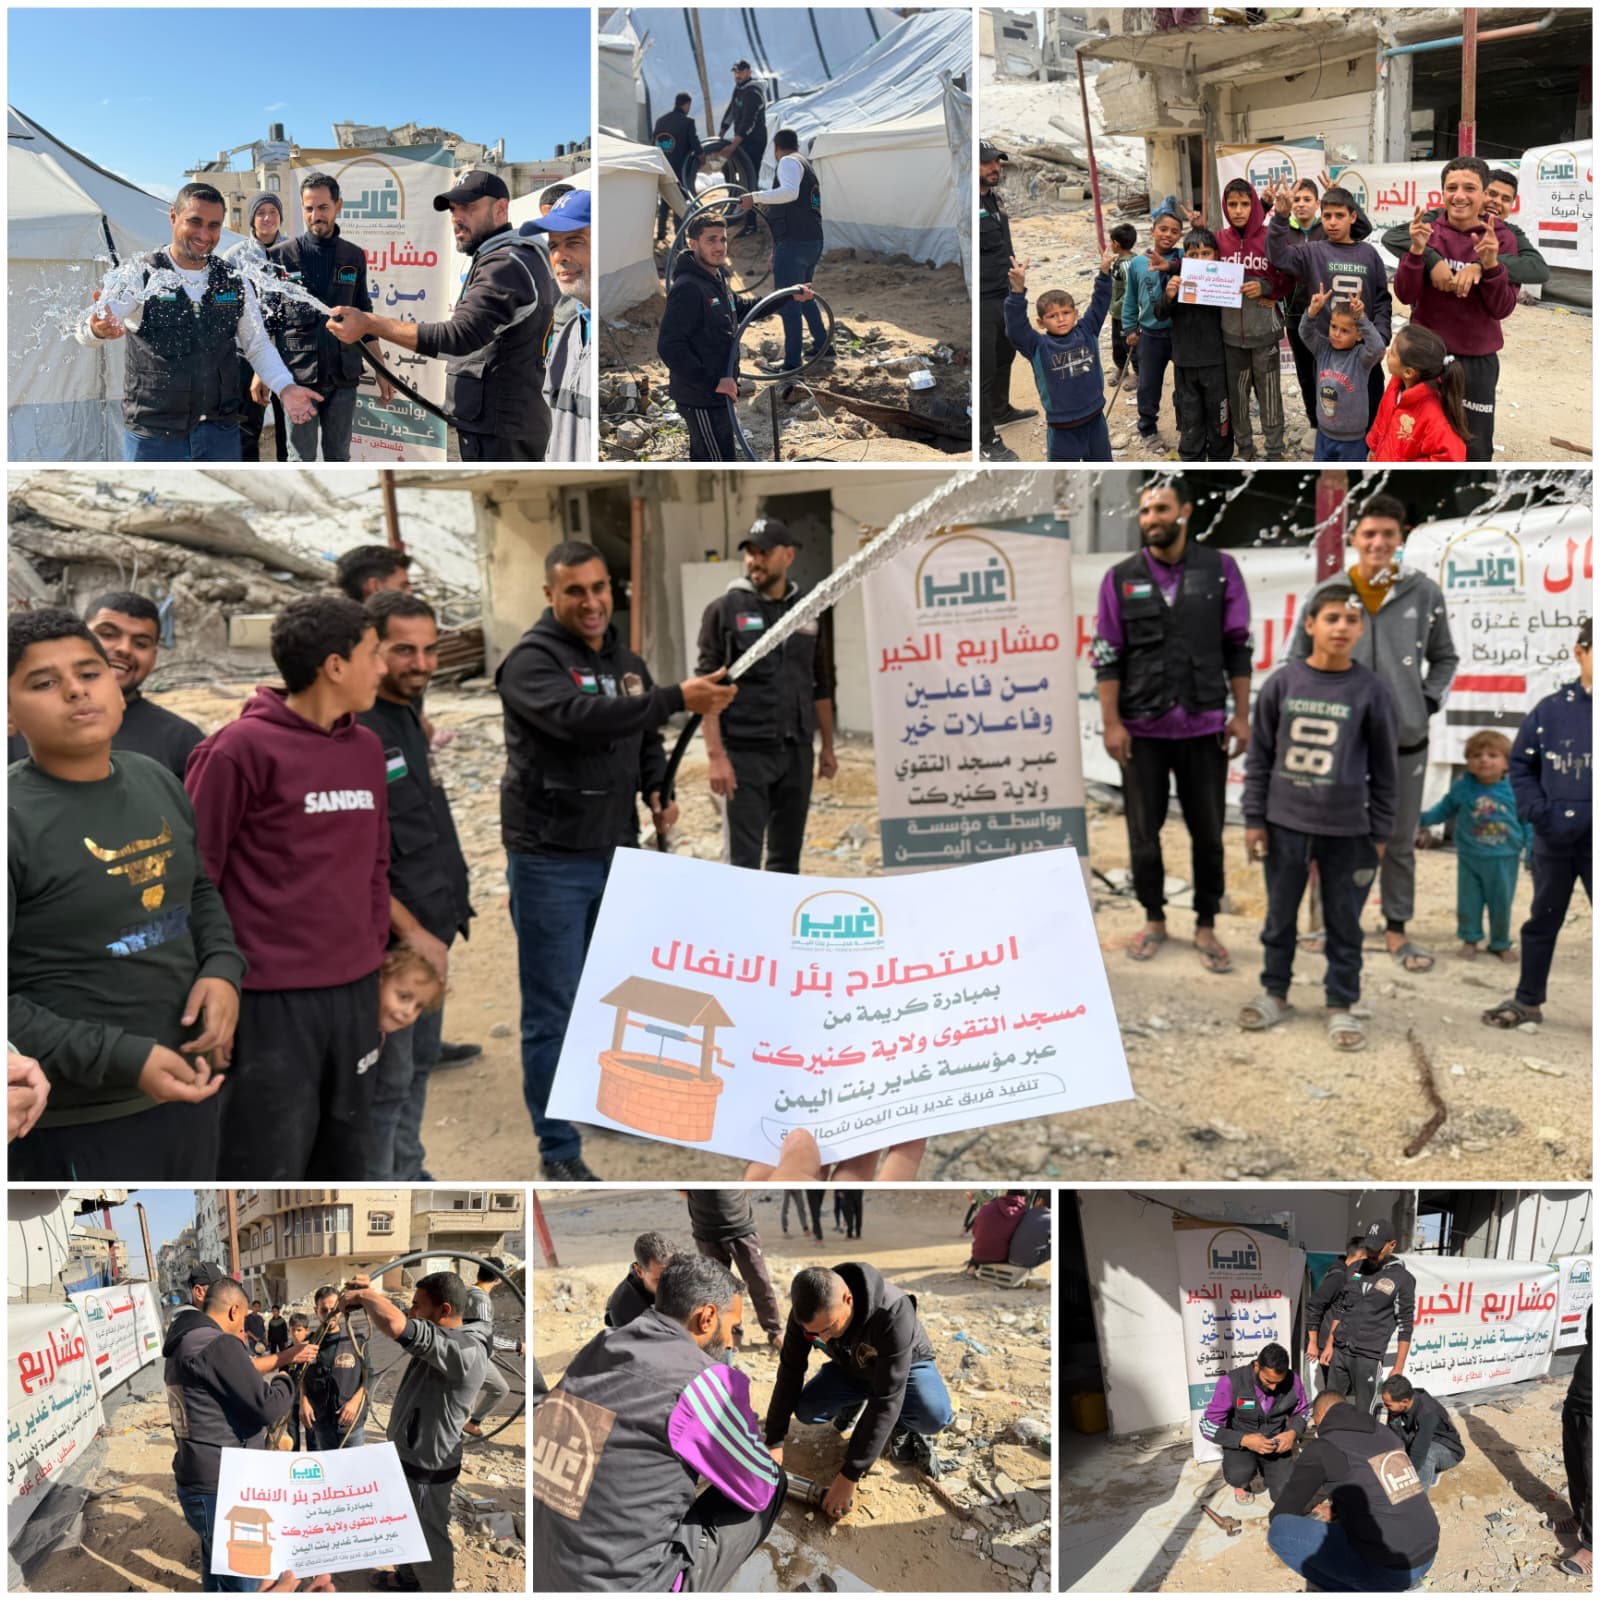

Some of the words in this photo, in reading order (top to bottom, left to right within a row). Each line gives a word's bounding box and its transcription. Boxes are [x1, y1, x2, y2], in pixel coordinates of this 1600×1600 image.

[336, 179, 397, 219] غدي
[1373, 180, 1417, 211] الخير
[1551, 190, 1575, 204] غزة
[1551, 203, 1580, 219] أمريكا
[363, 240, 438, 272] مشاري
[385, 283, 426, 306] من
[1462, 399, 1493, 413] SANDER
[390, 424, 436, 439] غدير
[923, 557, 1006, 608] غدير
[1471, 611, 1521, 634] غزة
[1527, 609, 1589, 633] قطاع
[879, 632, 942, 673] الخير
[956, 624, 1060, 667] مشاريع
[1472, 636, 1530, 665] أمريكا
[1535, 643, 1570, 671] في
[905, 674, 992, 708] فاعلين
[1001, 674, 1049, 701] من
[1287, 699, 1351, 719] SCOREMIX
[900, 713, 936, 745] خير
[943, 706, 1053, 737] وفاعلات
[957, 755, 1011, 775] مسجد
[1017, 750, 1057, 771] عبر
[304, 789, 376, 814] SANDER
[907, 783, 997, 809] كنيركت
[1003, 780, 1048, 804] ولاية
[907, 819, 982, 836] مؤسسة
[987, 811, 1062, 833] بواسطة
[895, 839, 971, 861] اليمن
[800, 905, 877, 939] غدير
[650, 939, 778, 988] الانفال
[844, 935, 1020, 998] استصلاح
[789, 961, 834, 999] بئر
[932, 983, 1002, 1011] بمبادرة
[822, 1008, 853, 1031] من
[855, 998, 930, 1026] كريمة
[1012, 1003, 1087, 1032] مسجد
[932, 1016, 1008, 1049] التقوى
[751, 1040, 867, 1076] كنيركت
[871, 1031, 928, 1062] ولاية
[1019, 1044, 1057, 1066] عبر
[938, 1053, 1018, 1078] مؤسسة
[837, 1081, 876, 1103] بنت
[881, 1065, 933, 1096] غدير
[997, 1078, 1039, 1098] تنفيذ
[773, 1087, 834, 1114] اليمن
[921, 1095, 955, 1114] غدير
[957, 1087, 995, 1107] فريق
[854, 1108, 893, 1130] اليمن
[895, 1102, 920, 1118] بنت
[1211, 1243, 1257, 1270] غدير
[1185, 1283, 1223, 1304] الخير
[1229, 1283, 1283, 1304] مشاريع
[1412, 1281, 1474, 1326] الخير
[1480, 1281, 1557, 1323] مشاريع
[1202, 1308, 1250, 1327] فاعلين
[1252, 1309, 1277, 1324] من
[1200, 1327, 1219, 1347] خير
[1223, 1327, 1279, 1342] وفاعلات
[1409, 1334, 1447, 1357] اليمن
[1448, 1331, 1469, 1351] بنت
[1470, 1328, 1497, 1349] غدير
[17, 1327, 85, 1395] مشاريع
[24, 1399, 50, 1438] غدير
[533, 1435, 584, 1492] غد
[1386, 1465, 1421, 1492] دير
[240, 1486, 288, 1503] الانفال
[291, 1490, 308, 1505] بئر
[312, 1480, 379, 1505] استصلاح
[325, 1521, 348, 1534] ولاية
[379, 1513, 408, 1525] مسجد
[280, 1525, 325, 1539] كنيركت
